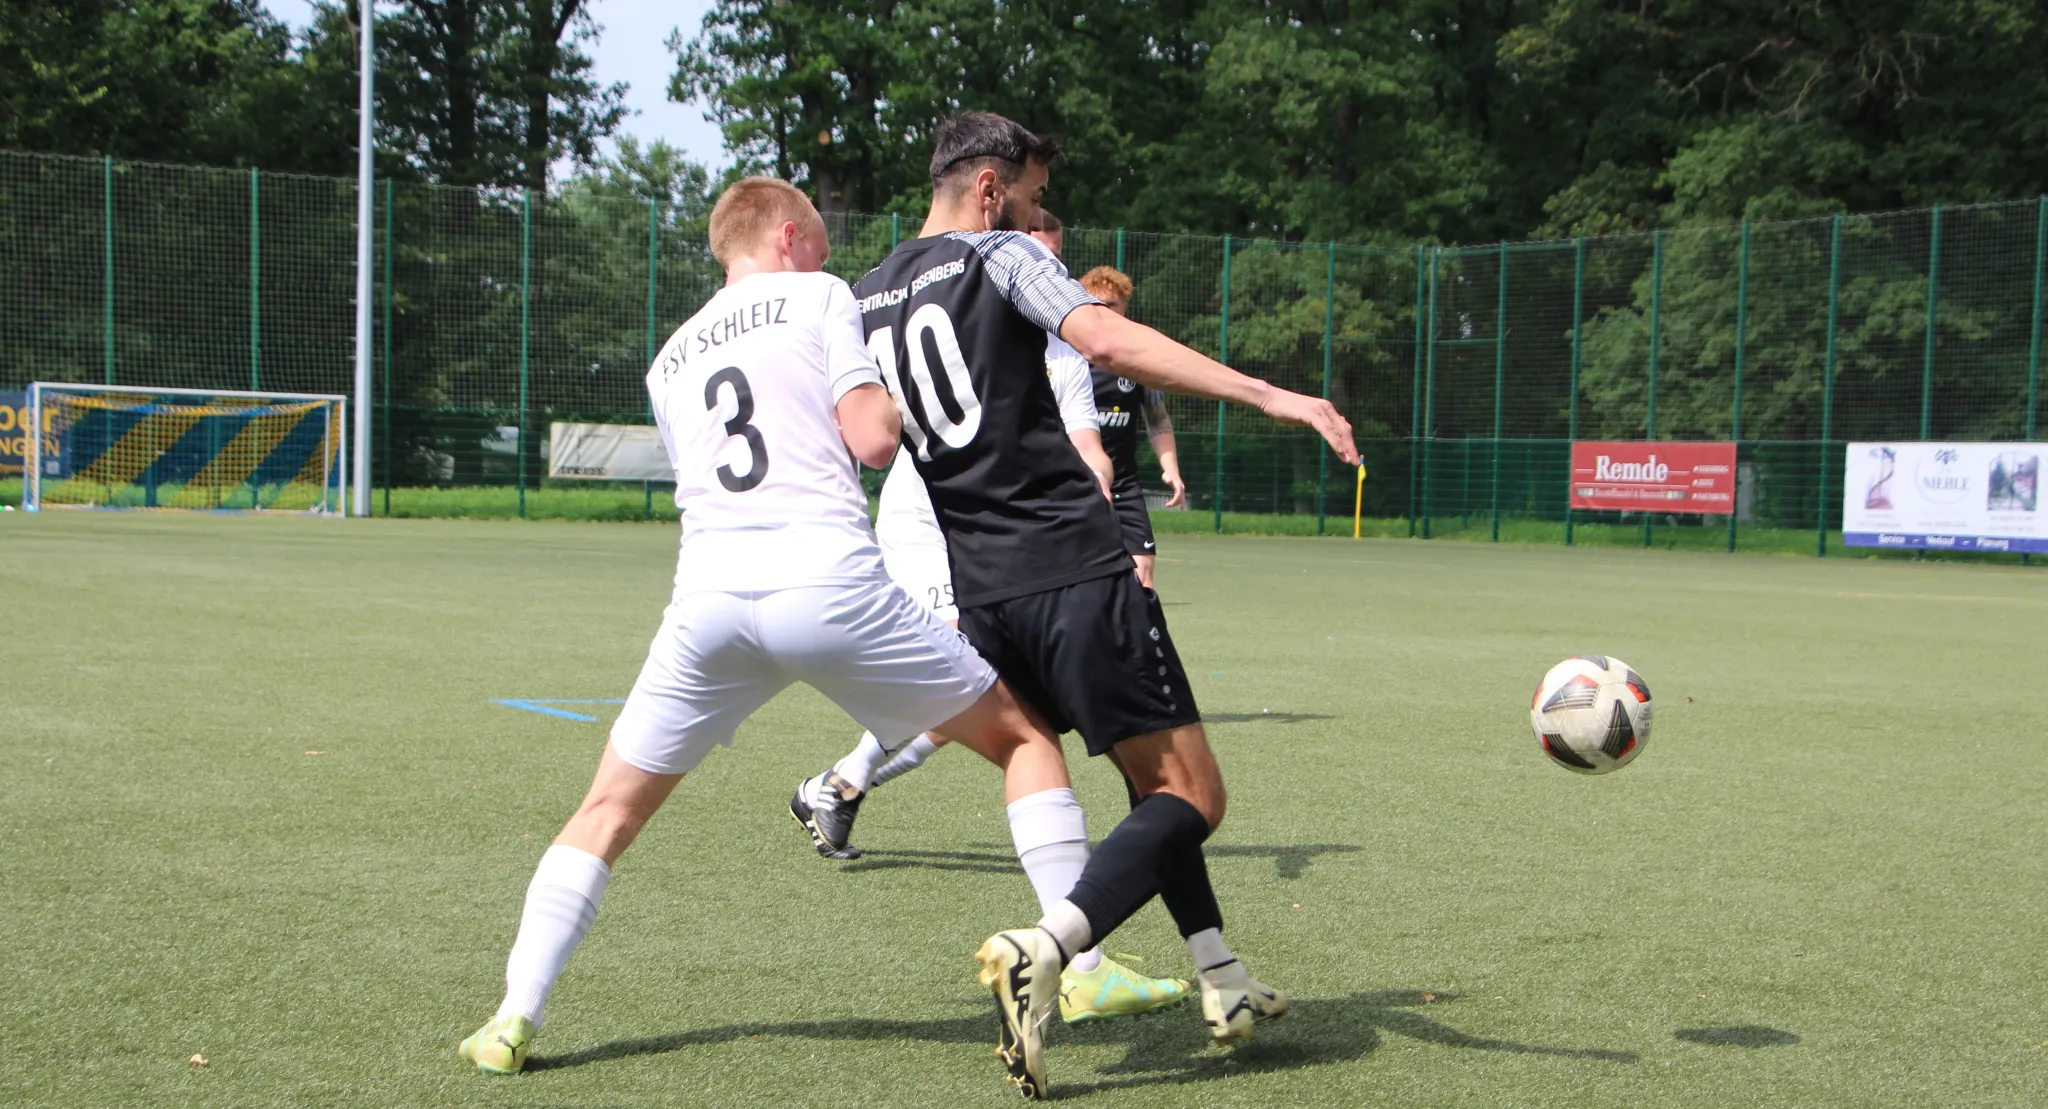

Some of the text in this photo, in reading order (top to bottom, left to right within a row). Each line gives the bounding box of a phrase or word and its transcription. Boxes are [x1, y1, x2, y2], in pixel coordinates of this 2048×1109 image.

[663, 297, 788, 384] FSV SCHLEIZ
[866, 303, 982, 462] 10
[704, 366, 769, 493] 3
[1594, 454, 1669, 482] Remde
[1878, 533, 1906, 544] Service
[1926, 534, 1955, 546] Verkauf
[1975, 536, 2009, 551] Planung
[927, 584, 955, 610] 25
